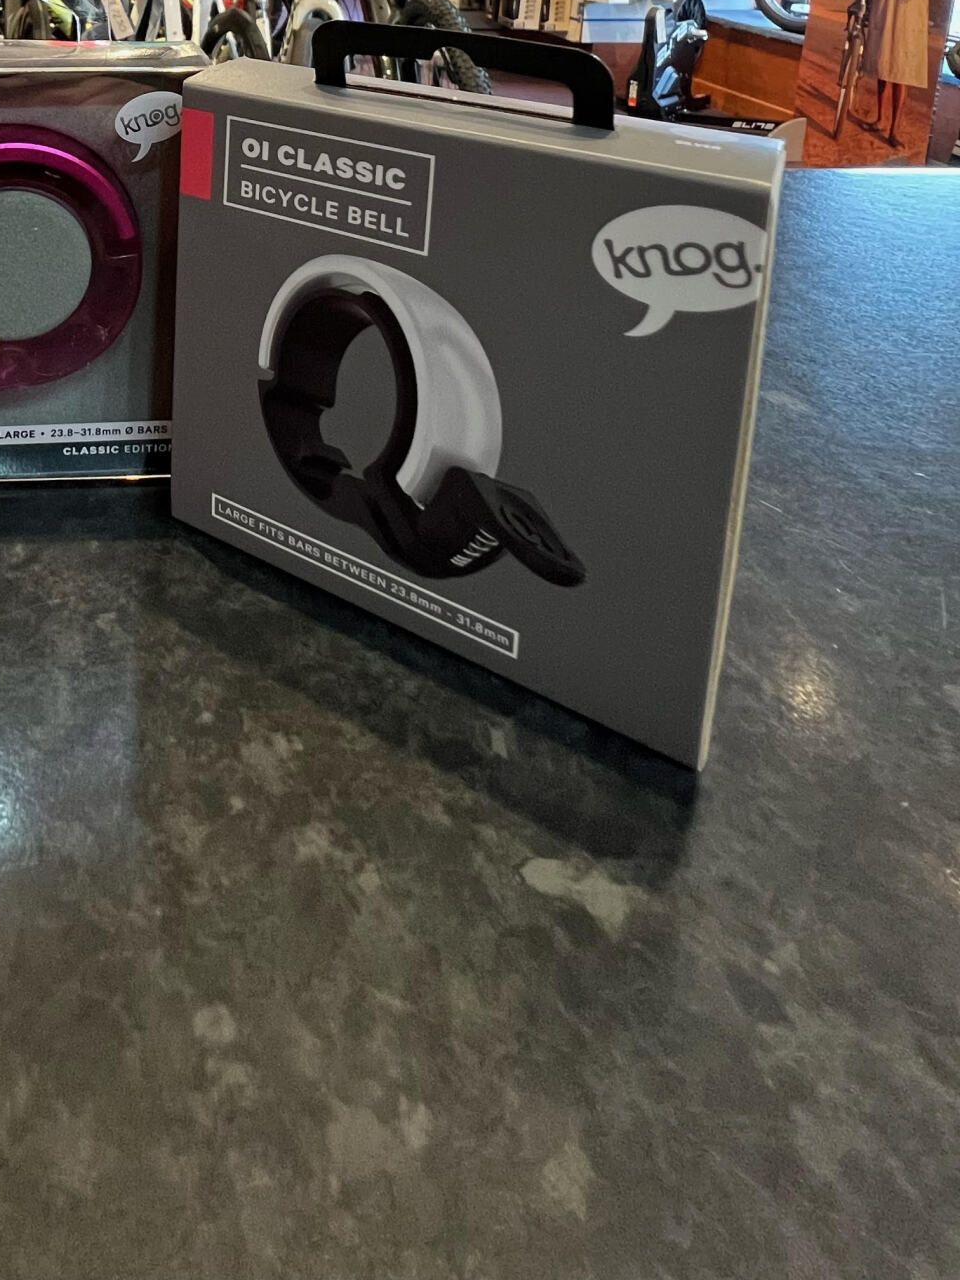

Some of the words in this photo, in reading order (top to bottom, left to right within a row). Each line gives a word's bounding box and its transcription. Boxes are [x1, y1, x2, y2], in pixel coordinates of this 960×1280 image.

[241, 138, 270, 161] OI
[277, 144, 407, 190] CLASSIC
[239, 180, 339, 220] BICYCLE
[347, 206, 410, 237] BELL
[62, 445, 120, 456] CLASSIC
[137, 424, 168, 435] BARS
[218, 503, 256, 529] LARGE
[259, 521, 285, 542] FITS
[288, 535, 321, 558] BARS
[324, 552, 387, 590] BETWEEN
[390, 582, 442, 614] 23.8mm
[456, 612, 510, 647] 31.8mm
